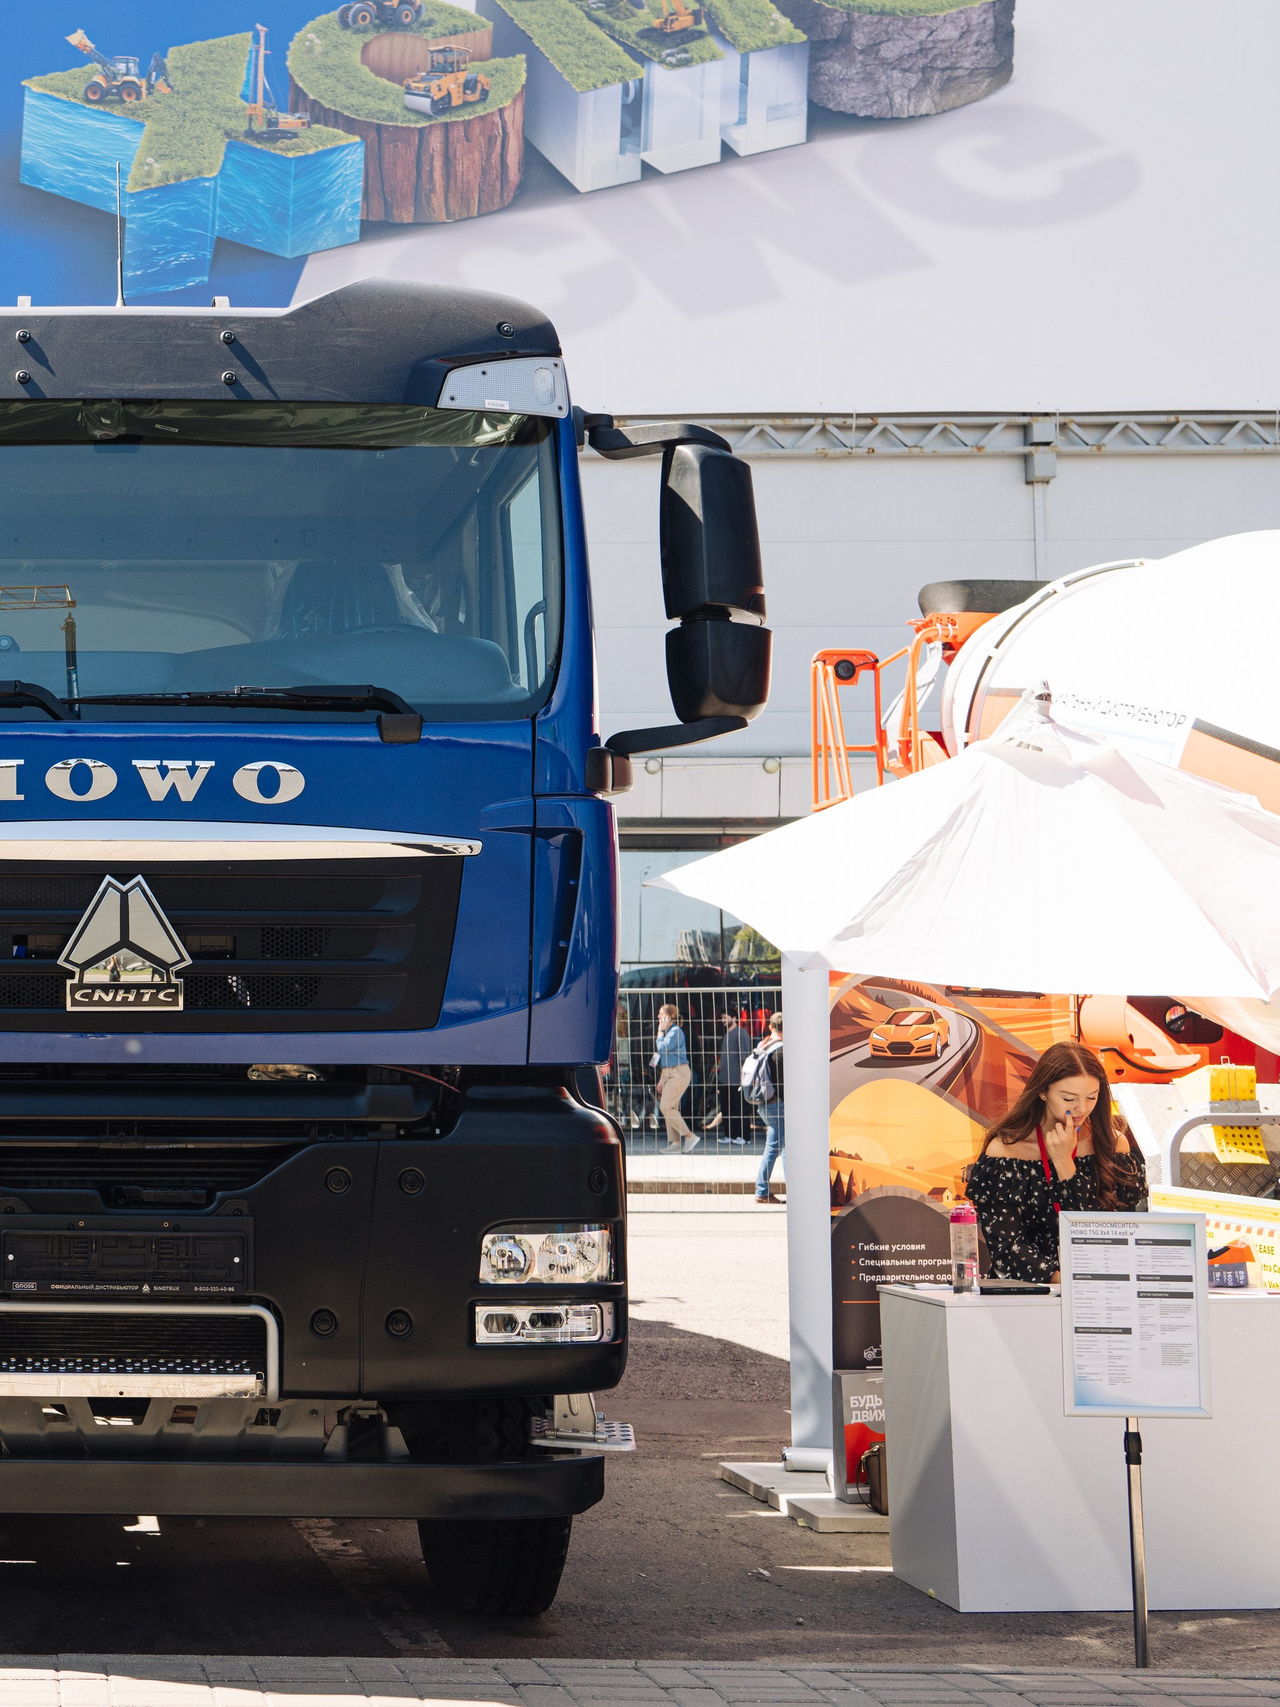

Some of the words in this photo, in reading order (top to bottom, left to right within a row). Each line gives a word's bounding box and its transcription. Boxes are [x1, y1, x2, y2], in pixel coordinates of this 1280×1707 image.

[74, 988, 177, 1002] CNHTC
[858, 1243, 889, 1251] Гибкие
[891, 1243, 925, 1252] условия
[859, 1258, 916, 1266] Специальные
[859, 1273, 934, 1283] Предварительное
[850, 1394, 882, 1409] БУДЬ
